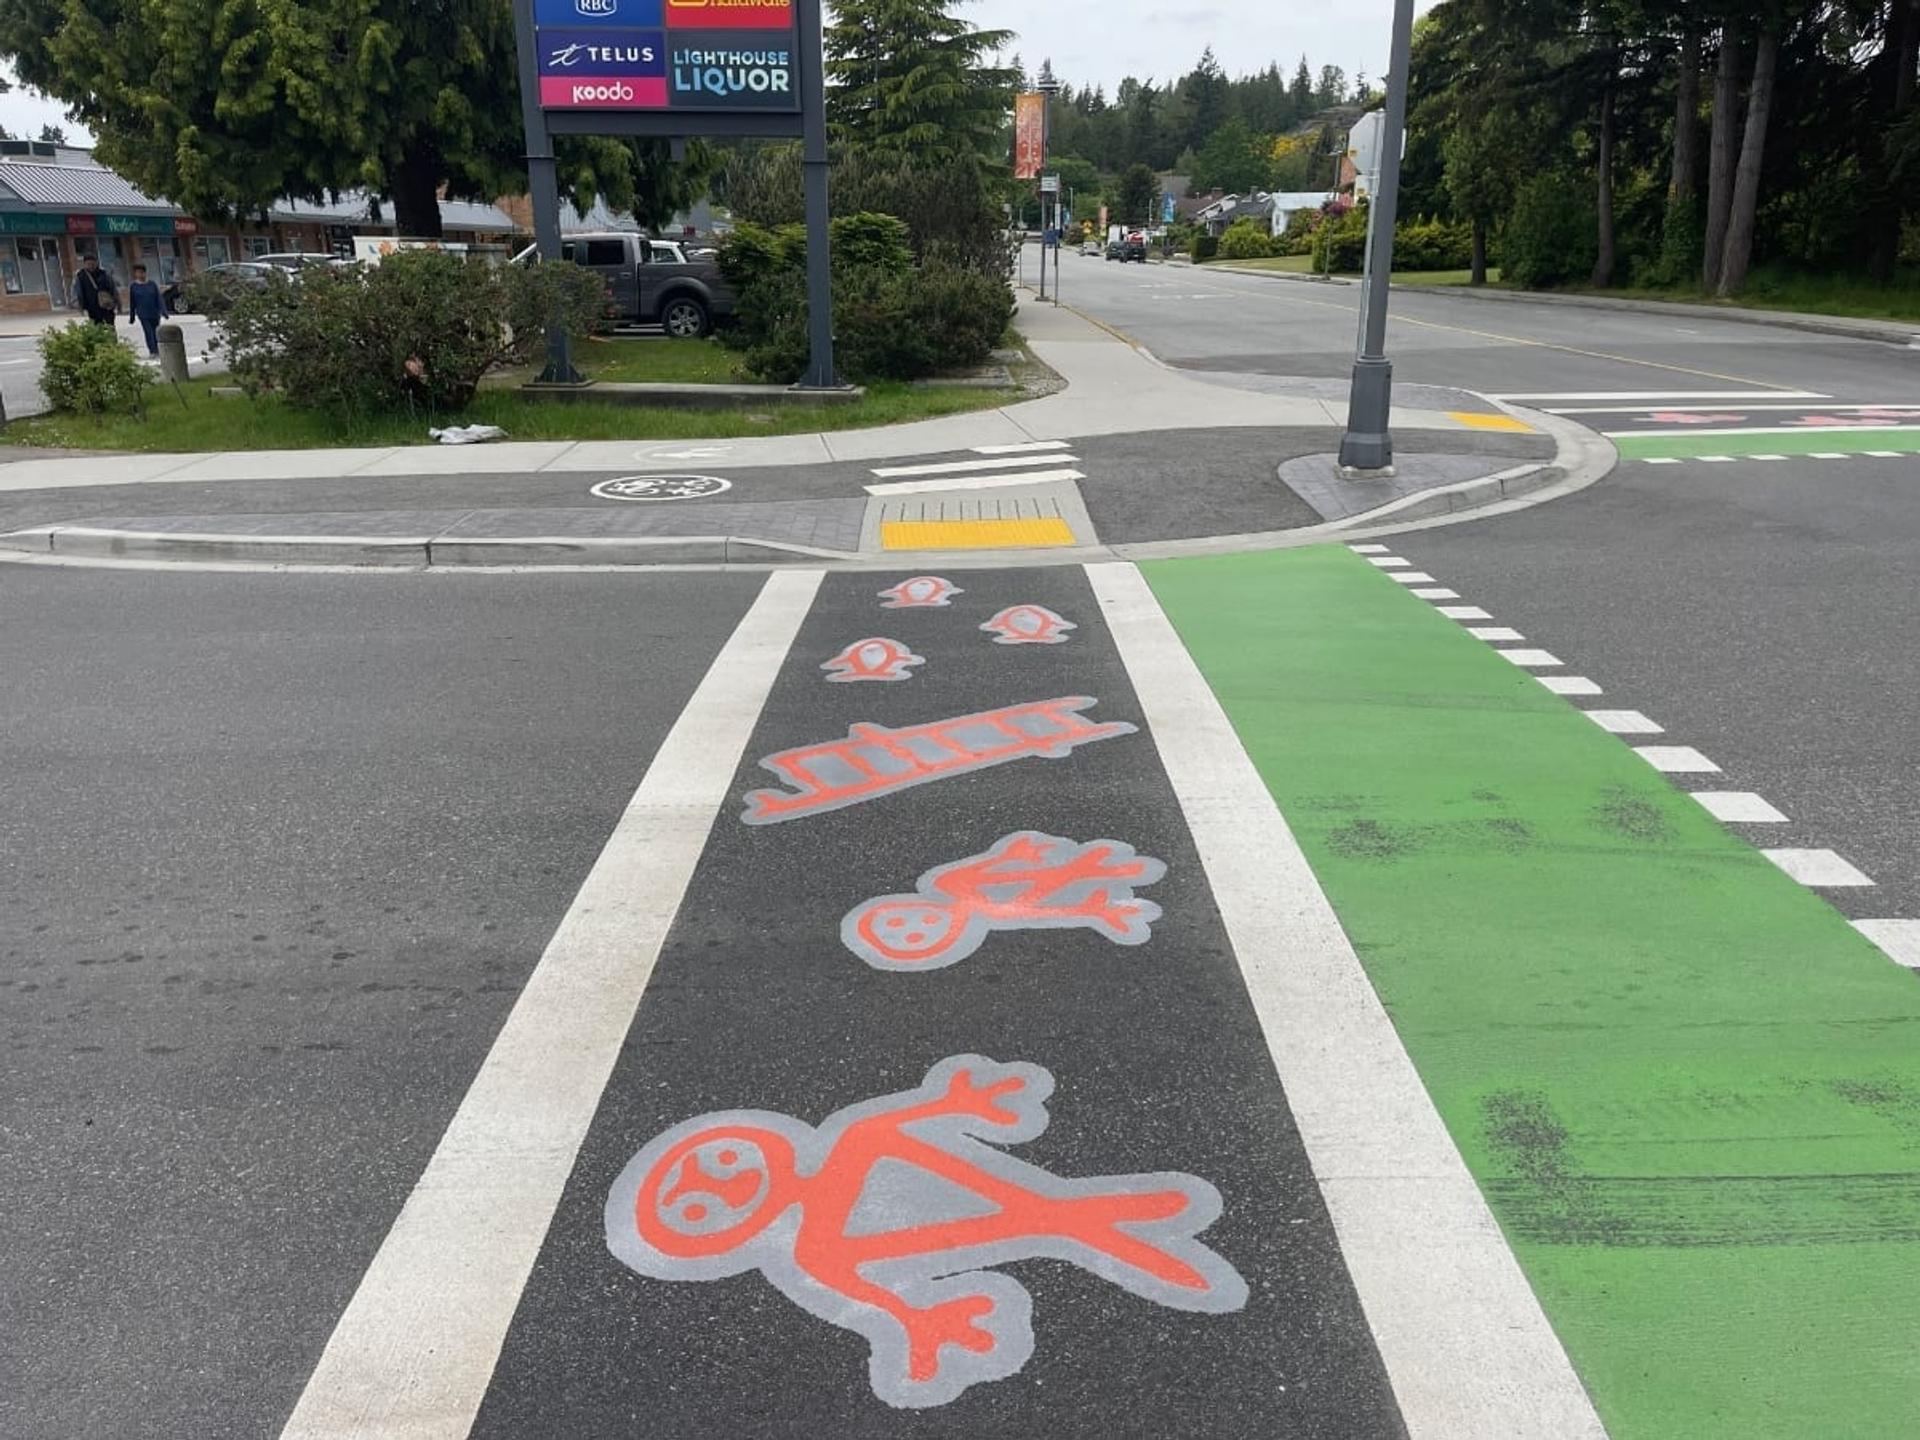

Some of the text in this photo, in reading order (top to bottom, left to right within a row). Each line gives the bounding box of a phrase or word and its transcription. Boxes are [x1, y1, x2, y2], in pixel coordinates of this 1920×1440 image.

[581, 0, 613, 11] RBC
[587, 47, 654, 62] TELUS
[673, 48, 789, 65] LIGHTHOUSE
[674, 67, 790, 96] LIQUOR
[573, 81, 634, 104] koodo
